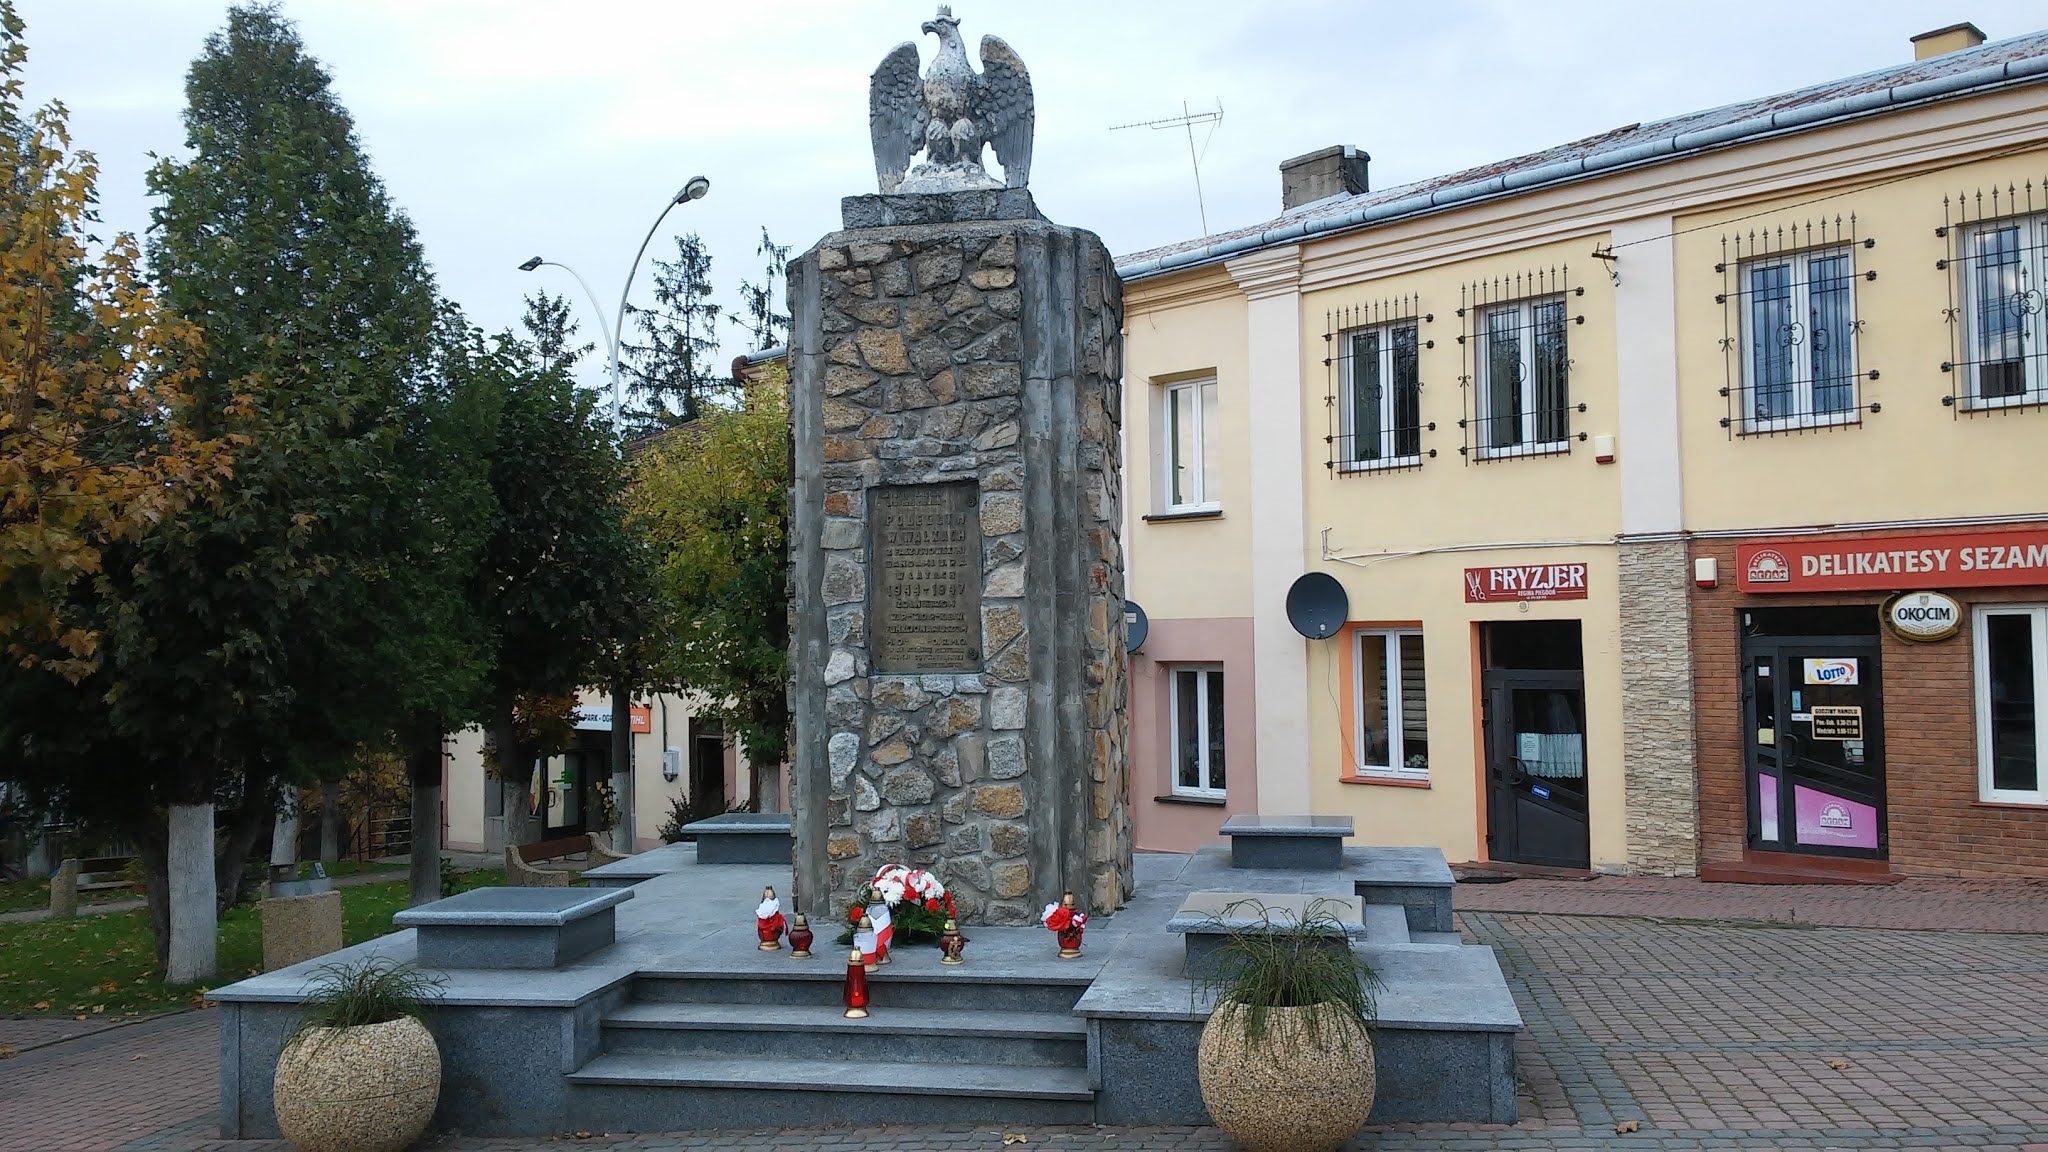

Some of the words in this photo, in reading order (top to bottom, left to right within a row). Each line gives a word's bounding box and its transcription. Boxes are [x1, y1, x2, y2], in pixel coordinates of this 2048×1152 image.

[1801, 549, 1952, 577] DELIKATESY
[1959, 544, 2048, 571] SEZAM
[1489, 565, 1585, 591] FRYZJER
[1750, 570, 1787, 580] SEZAM
[886, 583, 966, 597] 1944-1947
[1897, 607, 1951, 622] OKOCIM
[1816, 666, 1846, 681] LOTTO
[630, 715, 646, 725] TIHL
